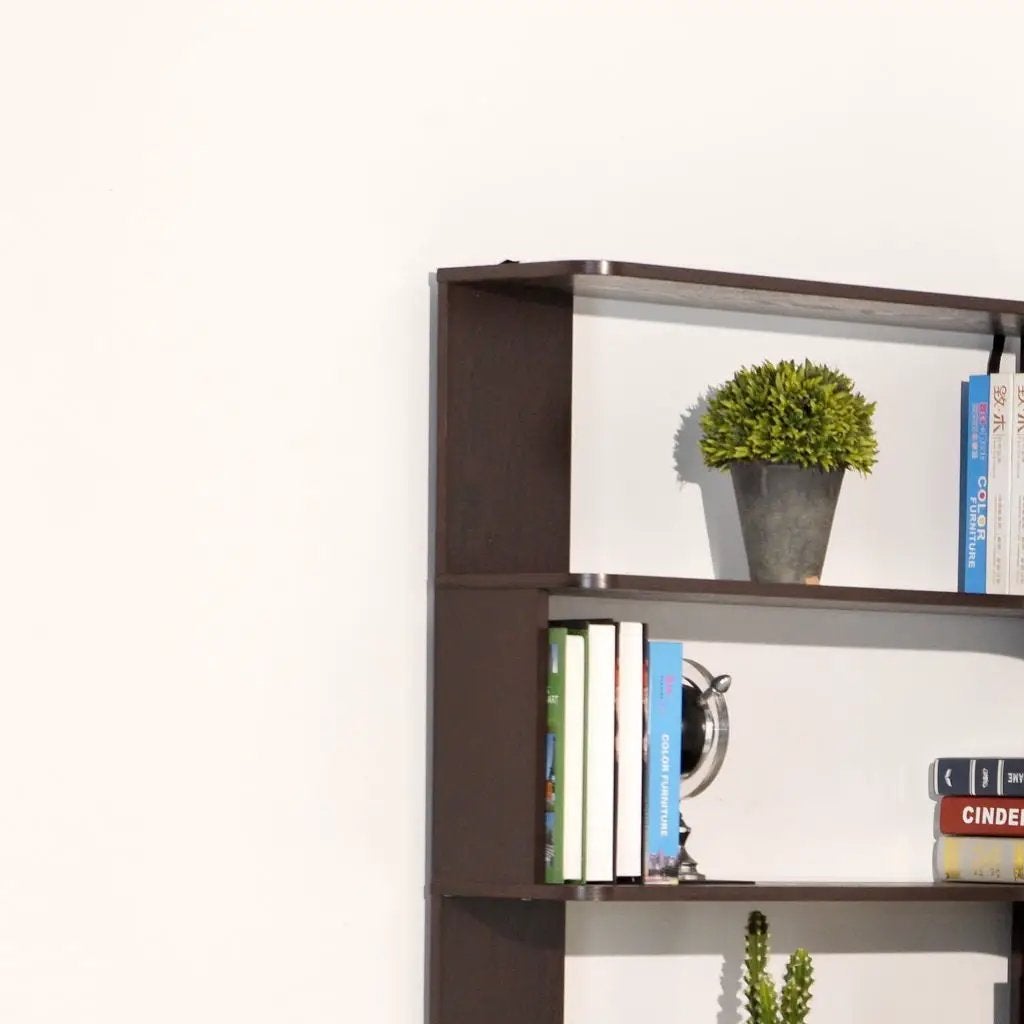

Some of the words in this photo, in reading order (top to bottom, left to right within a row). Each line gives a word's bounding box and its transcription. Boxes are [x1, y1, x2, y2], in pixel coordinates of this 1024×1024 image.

[968, 496, 978, 568] FURNITURE
[977, 475, 987, 541] COLOR
[661, 734, 671, 771] COLOR
[660, 774, 670, 837] FURNITURE
